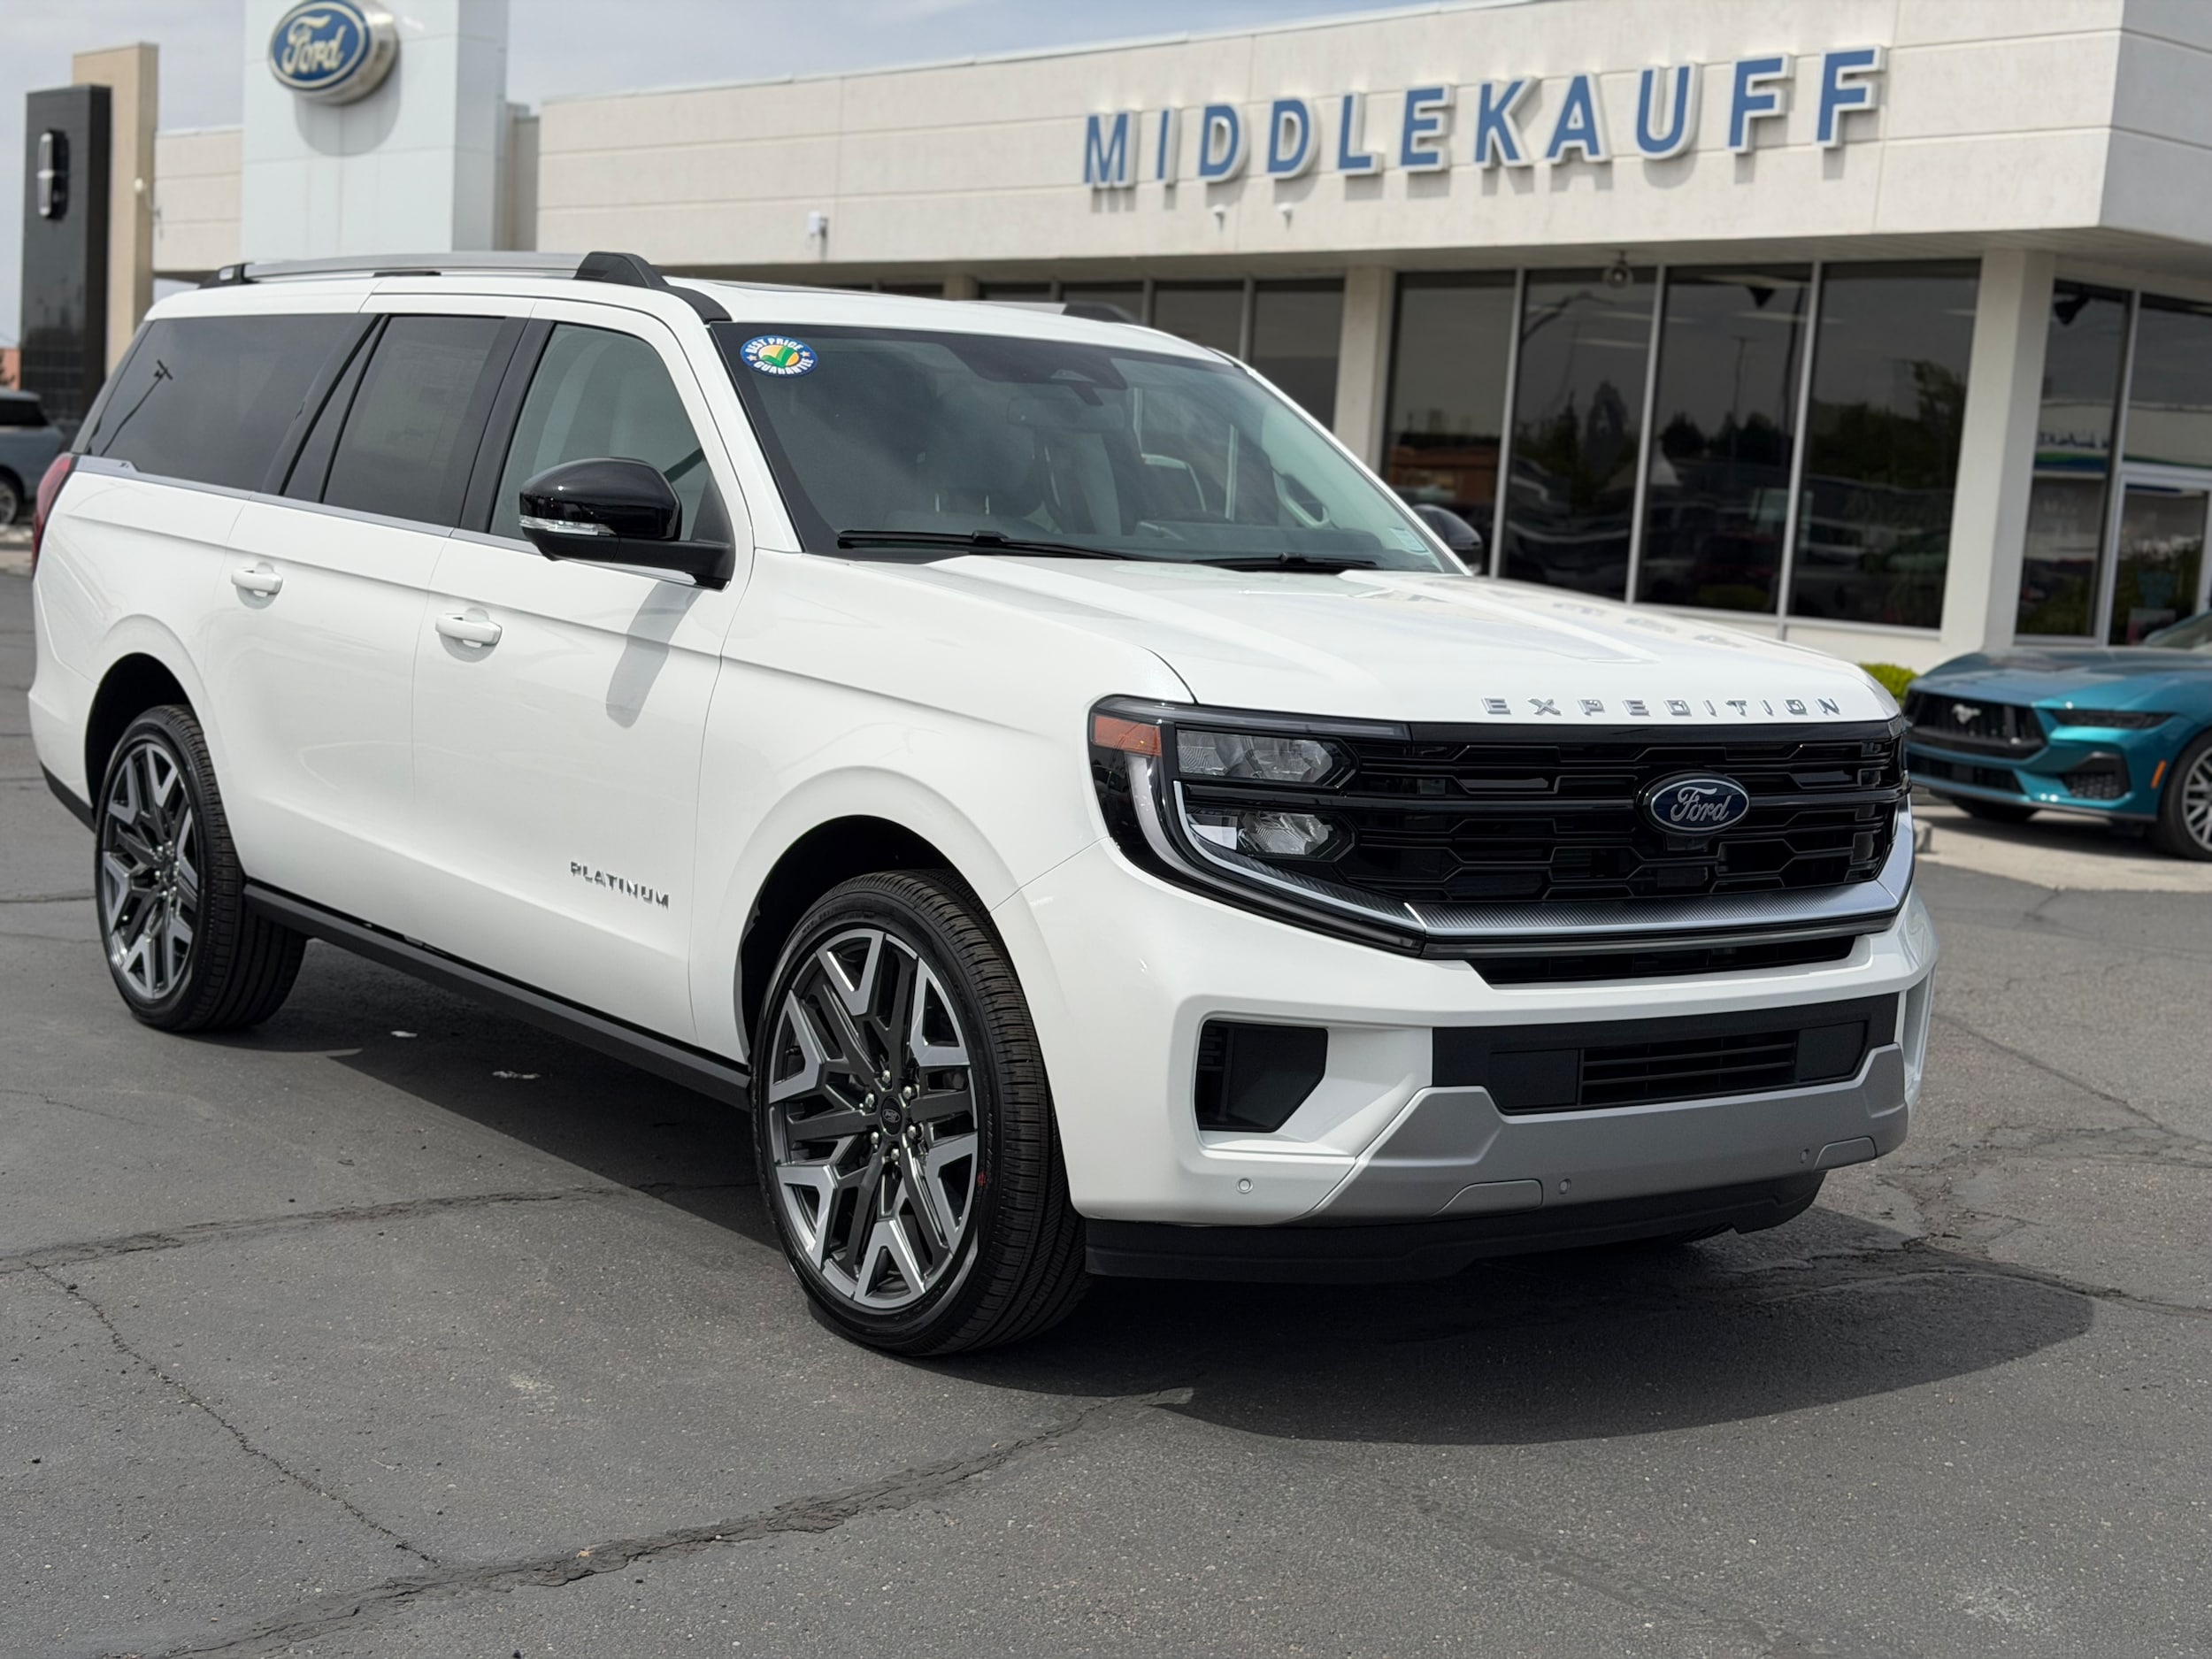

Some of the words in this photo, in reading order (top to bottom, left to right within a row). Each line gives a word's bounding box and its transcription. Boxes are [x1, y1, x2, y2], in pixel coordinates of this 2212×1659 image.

[281, 14, 347, 75] Ford
[1083, 47, 1890, 188] MIDDLEKAUFF
[745, 337, 768, 355] BEST
[768, 337, 804, 351] PRICE
[753, 357, 814, 375] GUARANTEE
[1480, 697, 1841, 717] EXPEDITION
[1670, 786, 1730, 822] Ford
[570, 861, 669, 910] PLATINUM
